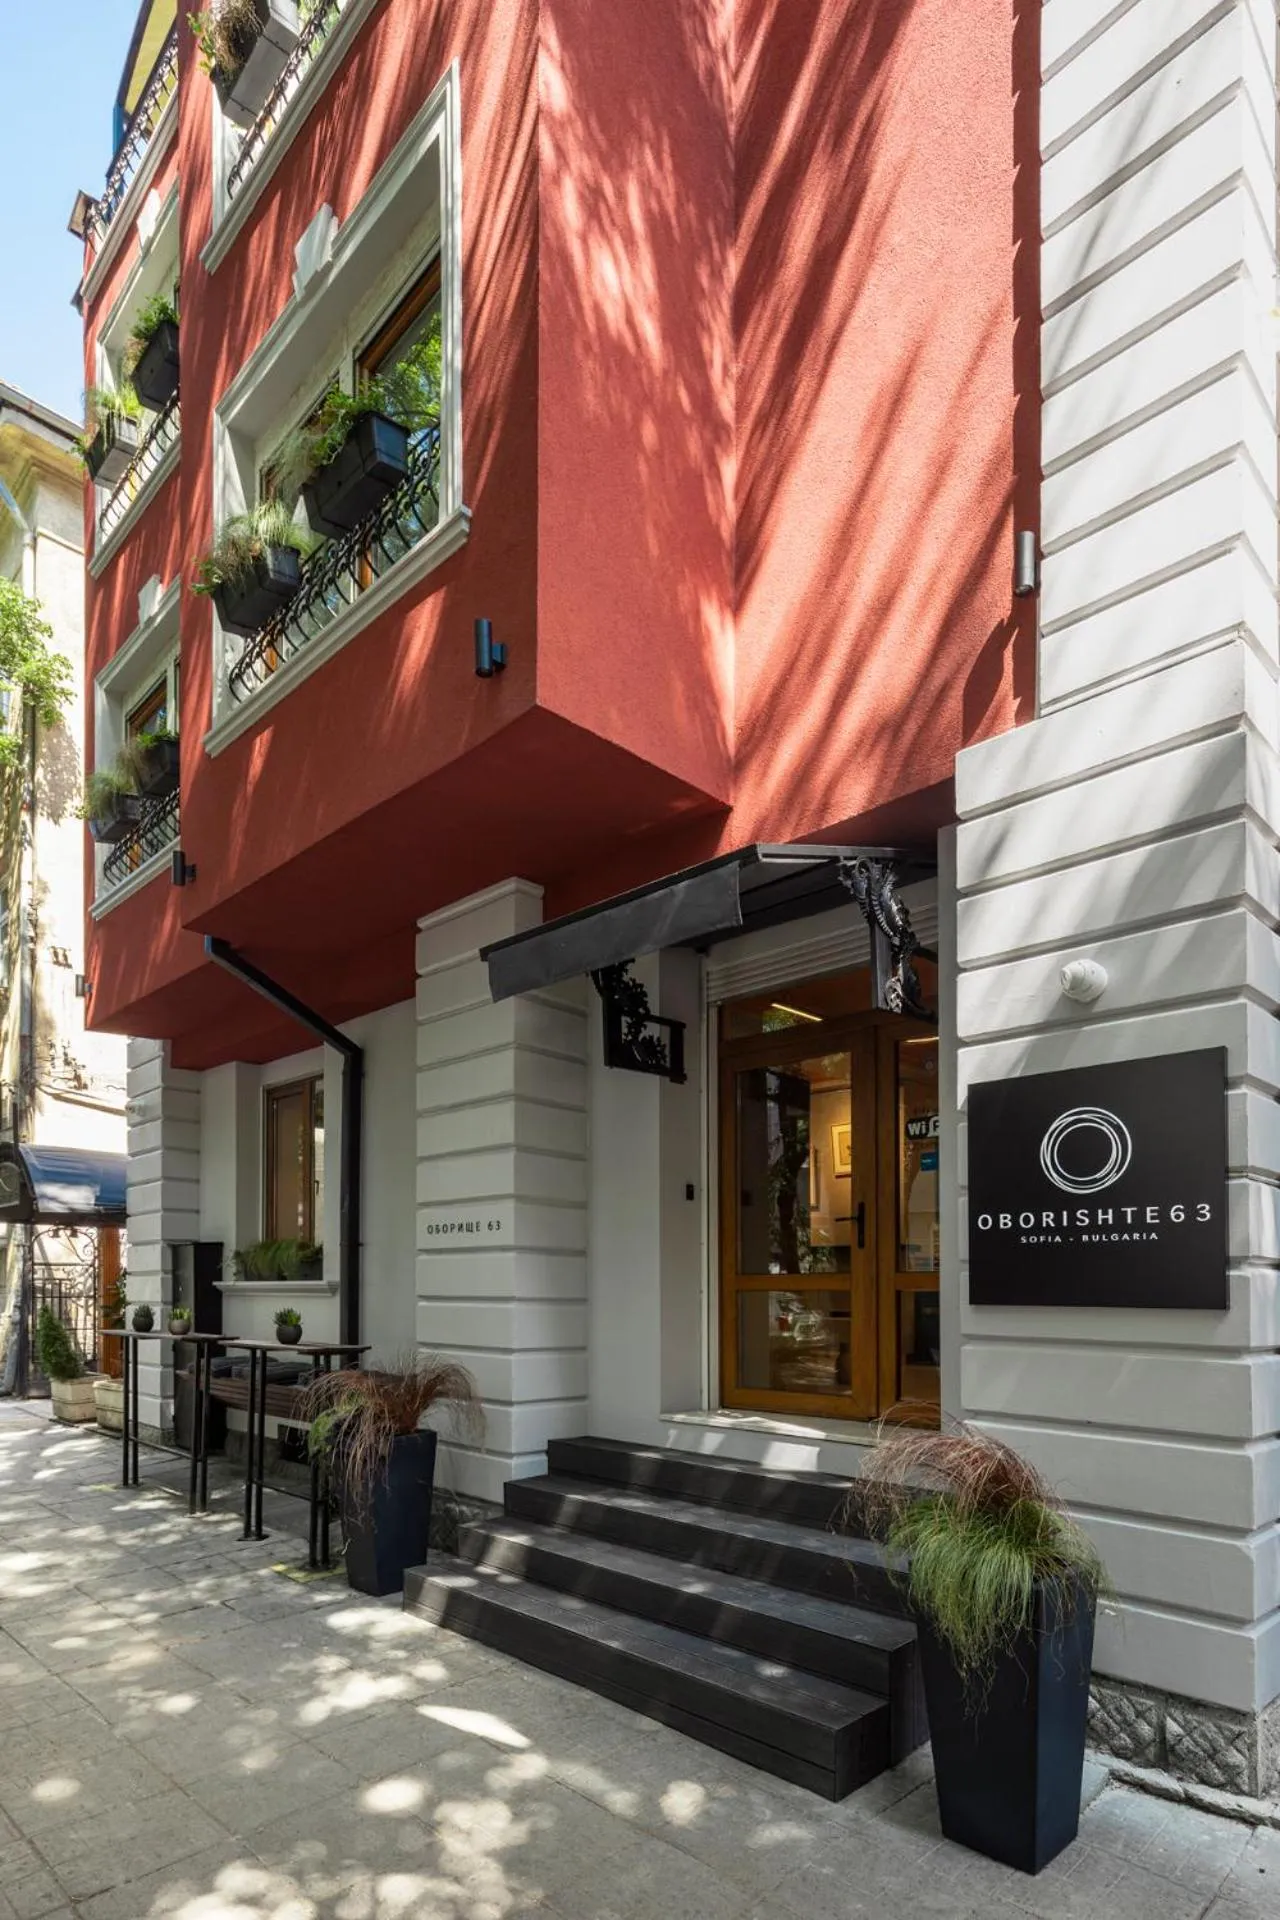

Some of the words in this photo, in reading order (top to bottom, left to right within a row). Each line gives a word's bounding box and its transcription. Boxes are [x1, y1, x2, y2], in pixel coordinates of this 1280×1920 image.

[977, 1206, 1160, 1230] OBORISHTE
[1169, 1203, 1212, 1223] 63
[487, 1220, 501, 1231] 63
[1020, 1235, 1062, 1244] SOFIA
[1081, 1232, 1159, 1243] BULGARIA
